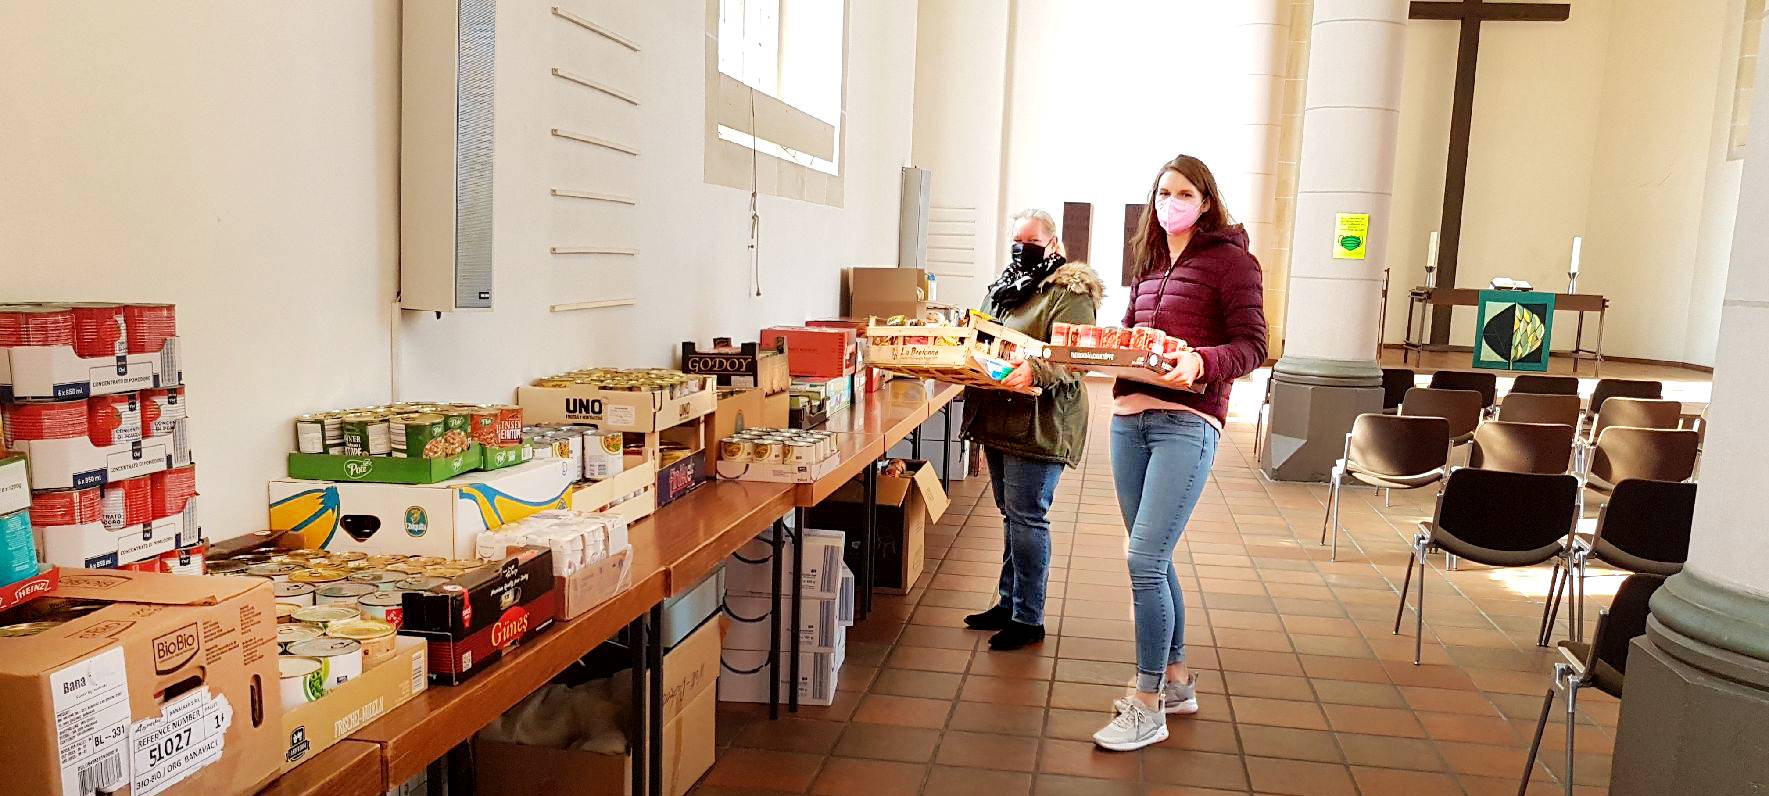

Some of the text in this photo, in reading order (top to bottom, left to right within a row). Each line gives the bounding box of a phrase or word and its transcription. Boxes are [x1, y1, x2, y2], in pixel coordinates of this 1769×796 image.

[688, 357, 751, 373] GODOY
[566, 398, 602, 415] UNO
[18, 582, 47, 599] HEINZ
[63, 677, 87, 695] Bana
[171, 709, 201, 732] NUMBER
[149, 727, 193, 768] 51027
[167, 760, 182, 774] ORG
